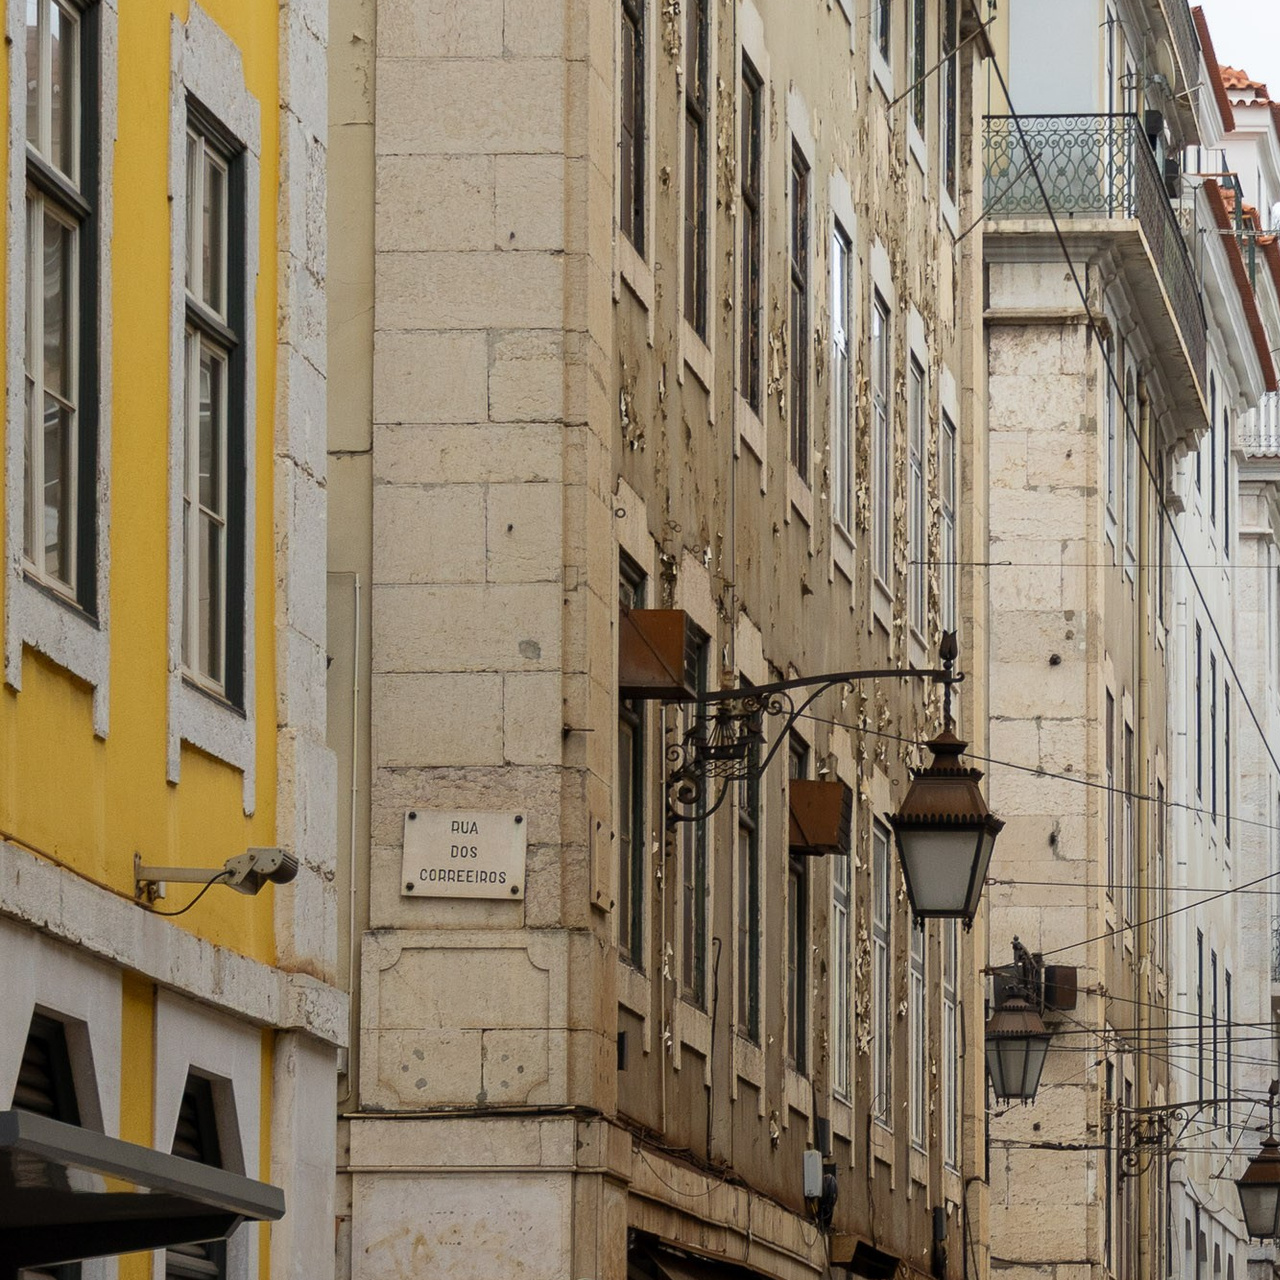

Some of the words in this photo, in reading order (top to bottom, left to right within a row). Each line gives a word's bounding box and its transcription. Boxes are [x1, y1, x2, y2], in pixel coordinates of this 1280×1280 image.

[451, 820, 479, 835] RUA
[450, 844, 478, 858] DOS
[419, 868, 507, 884] CORREEIROS
